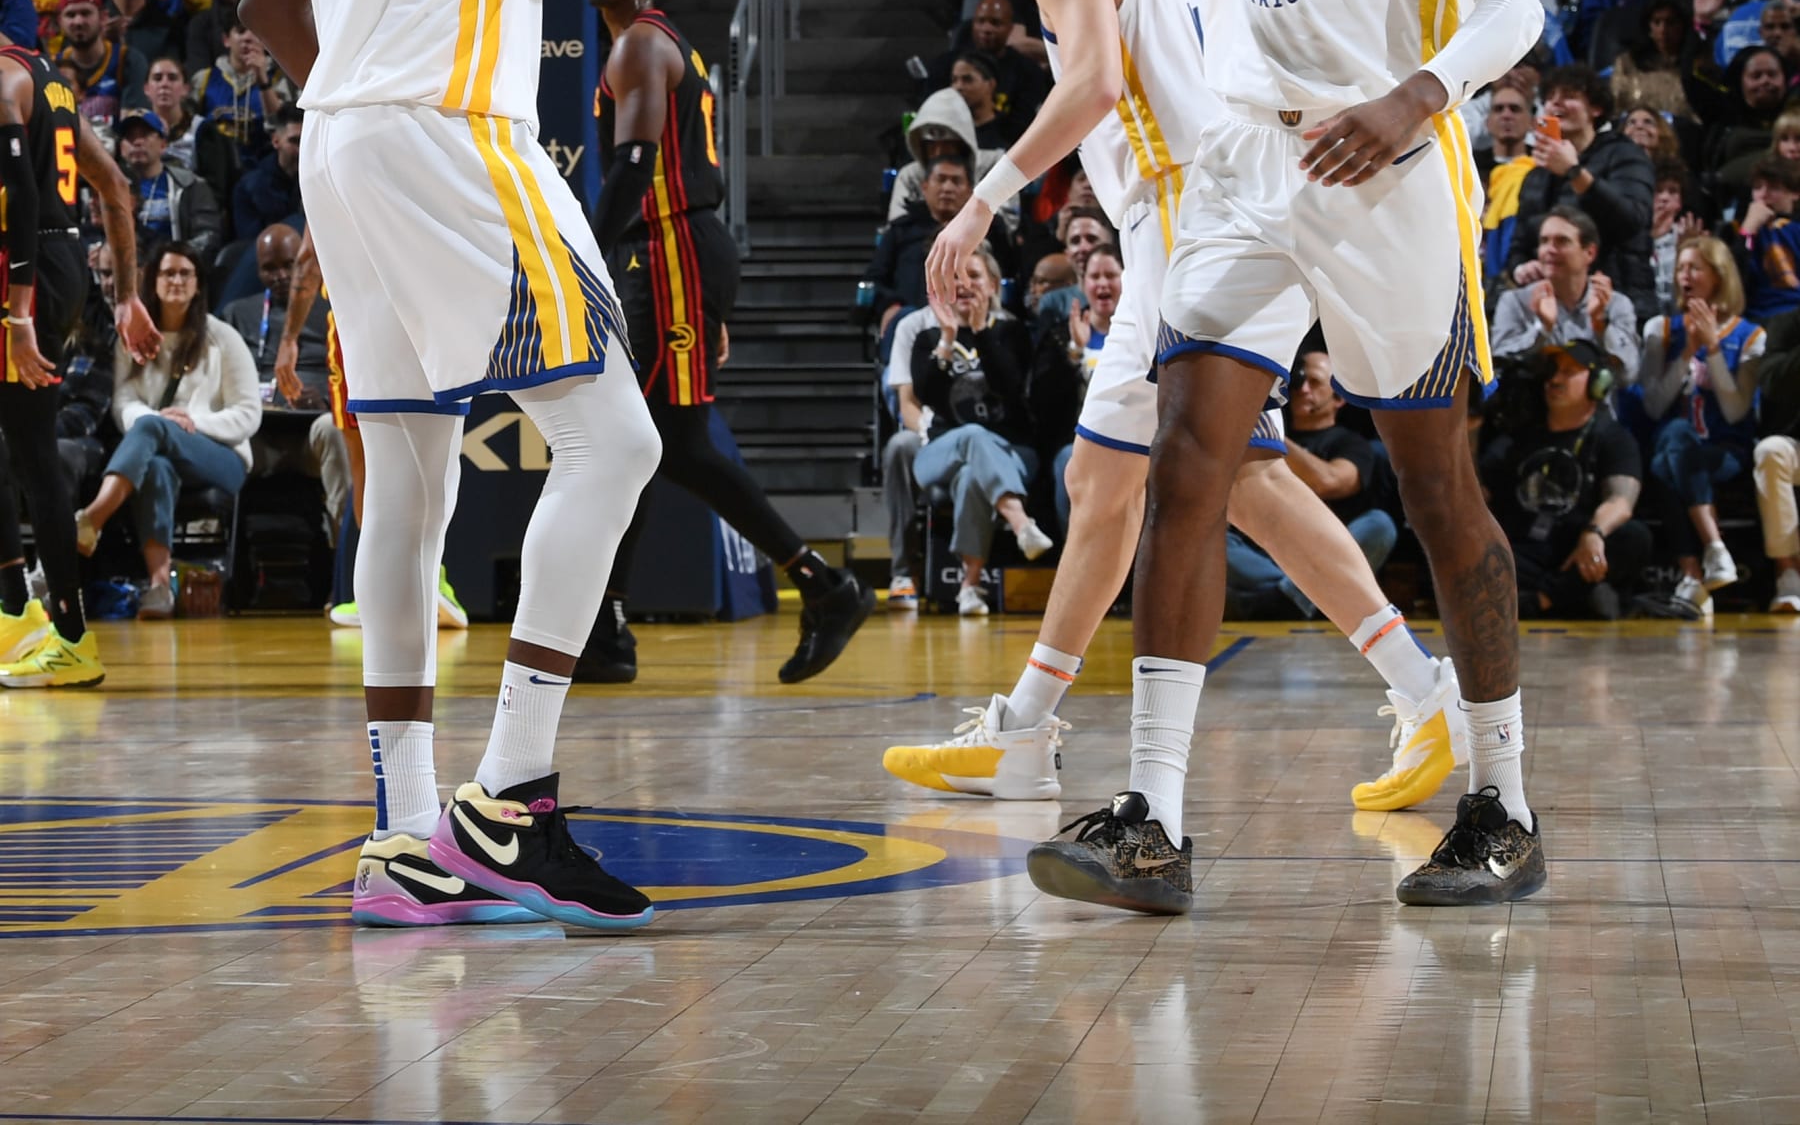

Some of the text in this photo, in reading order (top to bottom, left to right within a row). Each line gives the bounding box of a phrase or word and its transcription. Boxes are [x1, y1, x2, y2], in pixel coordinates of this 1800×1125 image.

[541, 39, 584, 58] ave
[55, 127, 79, 206] 5
[546, 138, 585, 177] ty
[460, 412, 553, 471] KI
